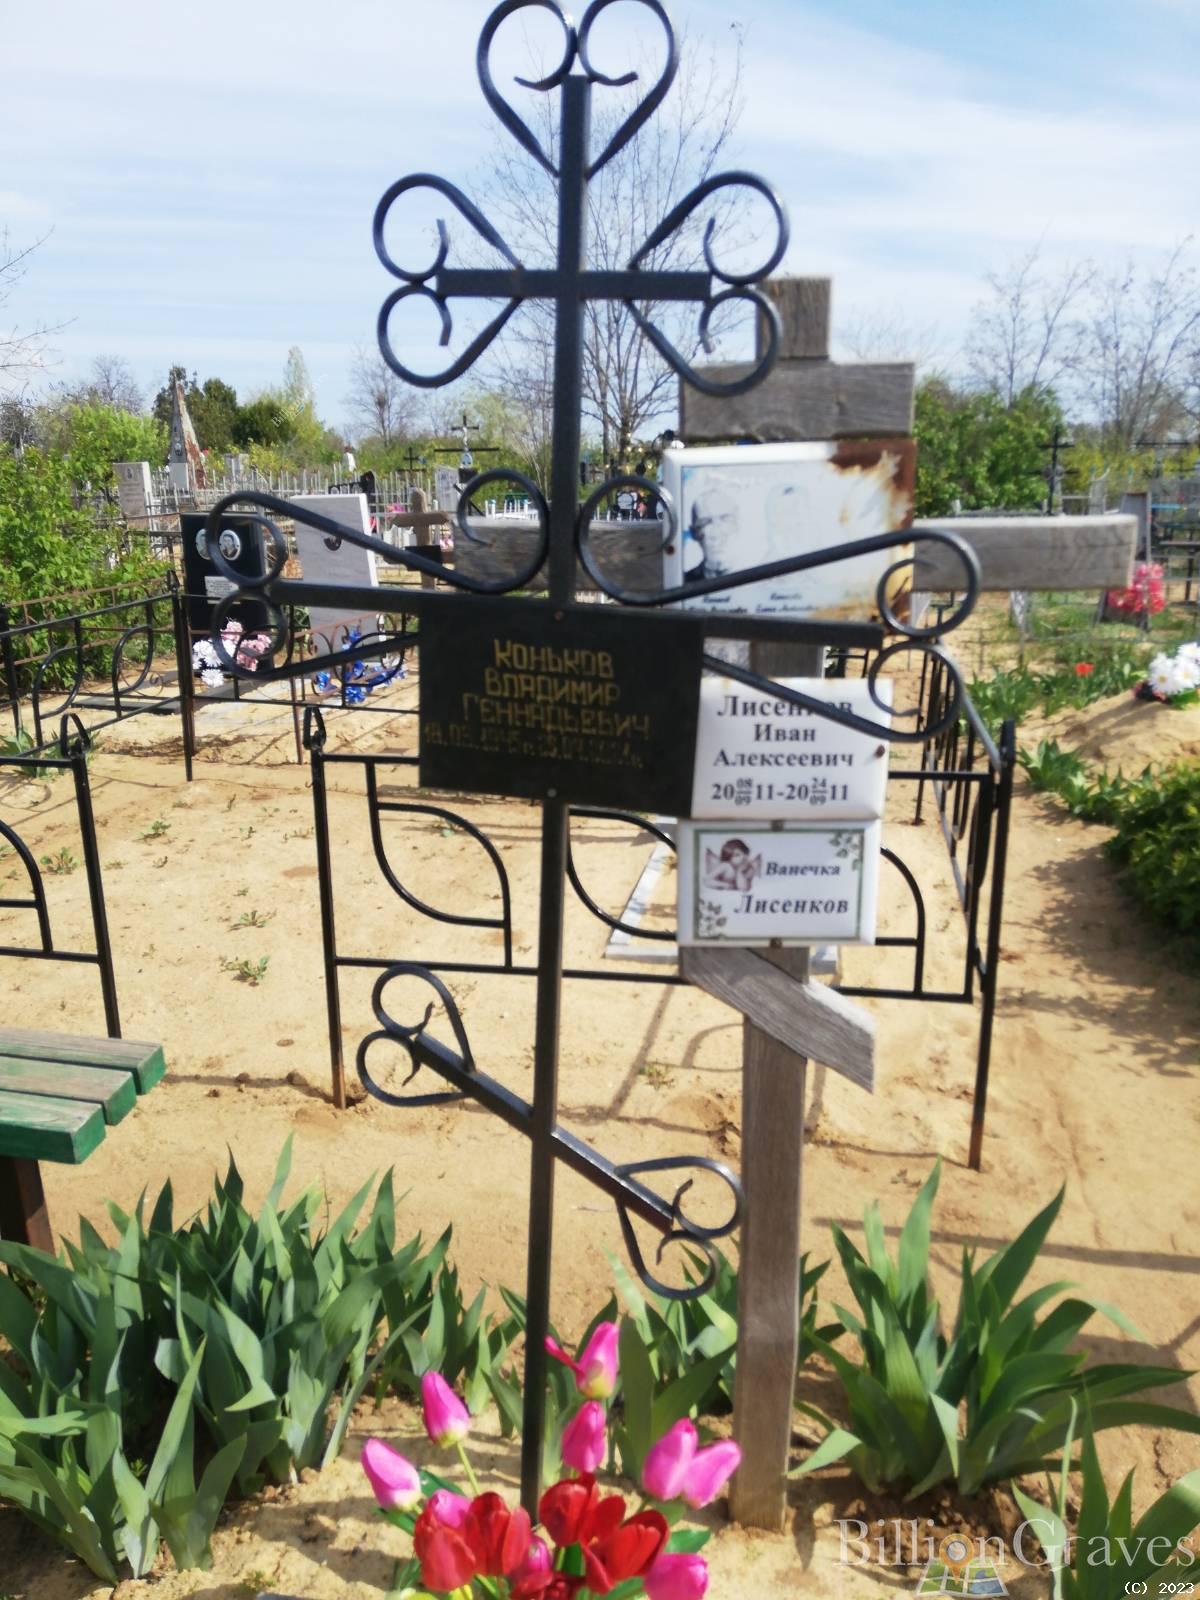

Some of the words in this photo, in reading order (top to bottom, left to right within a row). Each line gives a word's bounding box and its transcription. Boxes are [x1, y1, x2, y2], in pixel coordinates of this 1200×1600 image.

[493, 639, 614, 678] КОНЬКОВ
[484, 667, 620, 705] ВЛАДИМИР
[753, 723, 816, 743] Иван
[713, 749, 854, 768] Алексеевич
[765, 861, 842, 877] Ванечка
[733, 894, 850, 915] Лисенков
